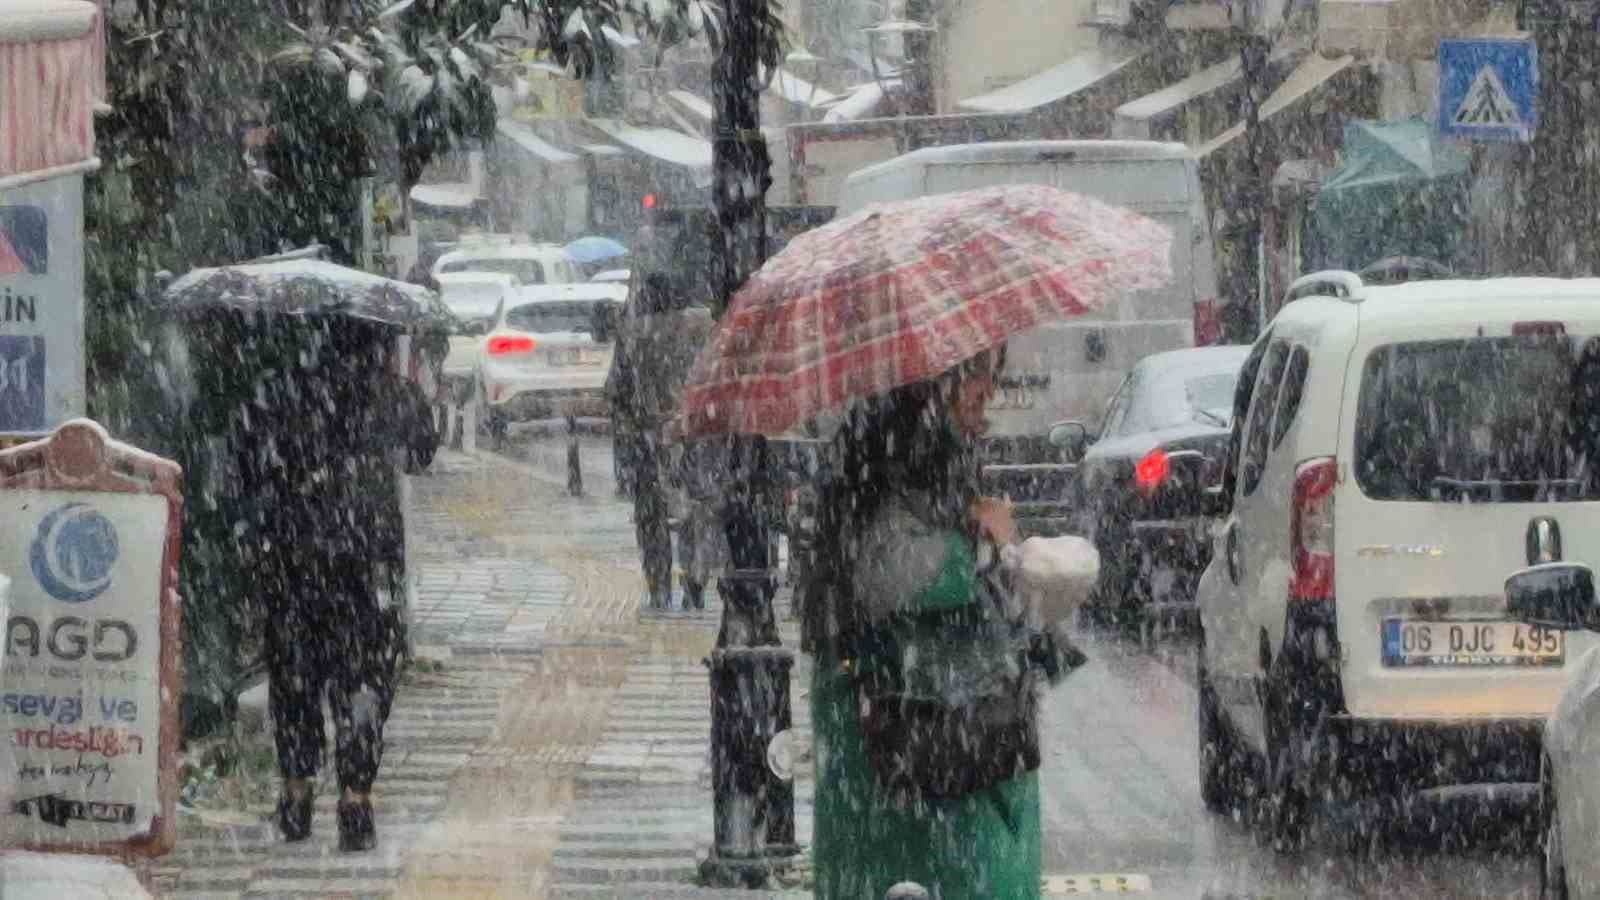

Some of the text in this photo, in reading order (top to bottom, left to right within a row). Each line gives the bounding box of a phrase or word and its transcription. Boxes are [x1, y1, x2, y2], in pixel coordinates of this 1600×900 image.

[0, 286, 36, 322] İN
[6, 616, 138, 661] AGD
[1450, 625, 1494, 653] DJC
[1512, 624, 1558, 653] 495
[99, 696, 137, 721] ve
